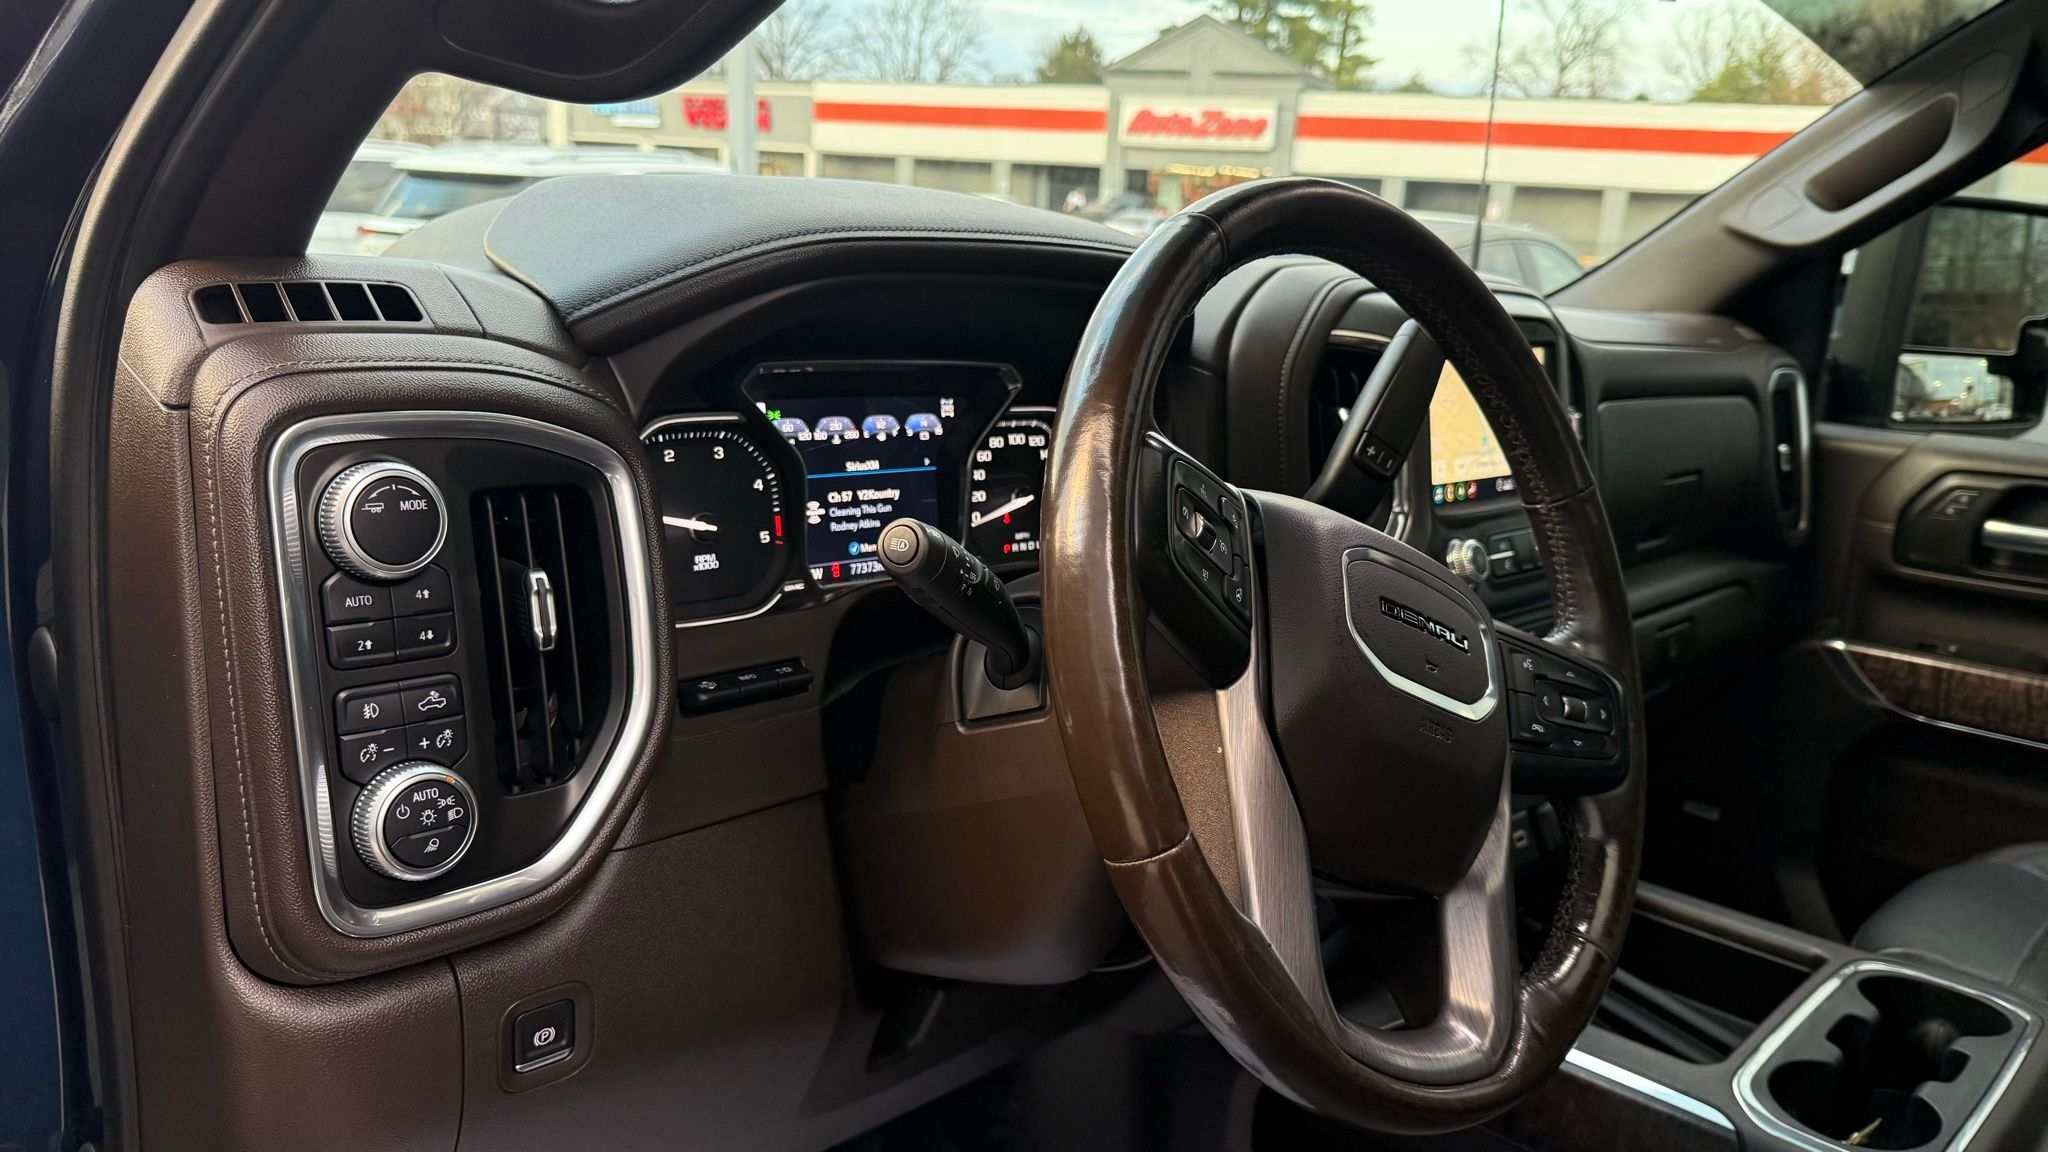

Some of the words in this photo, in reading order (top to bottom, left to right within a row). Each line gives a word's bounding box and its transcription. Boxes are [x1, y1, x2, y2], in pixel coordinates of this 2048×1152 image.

[1128, 109, 1268, 138] AutoZone
[1008, 433, 1026, 446] 100
[1028, 434, 1046, 447] 120
[663, 449, 676, 463] 2
[713, 446, 725, 460] 3
[845, 460, 880, 473] SiriusXM
[753, 479, 764, 492] 4
[827, 491, 841, 504] Ch
[857, 488, 900, 501] Y2Kountry
[400, 499, 428, 511] MODE
[829, 506, 861, 518] Cleaning
[861, 504, 877, 515] This
[876, 503, 893, 513] Gun
[830, 521, 859, 532] Rodney
[759, 531, 770, 544] 5
[860, 543, 878, 554] Men
[694, 553, 717, 564] RPM
[810, 568, 824, 580] W
[345, 595, 373, 608] AUTO
[1380, 599, 1469, 653] DENALI
[412, 788, 439, 803] AUTO
